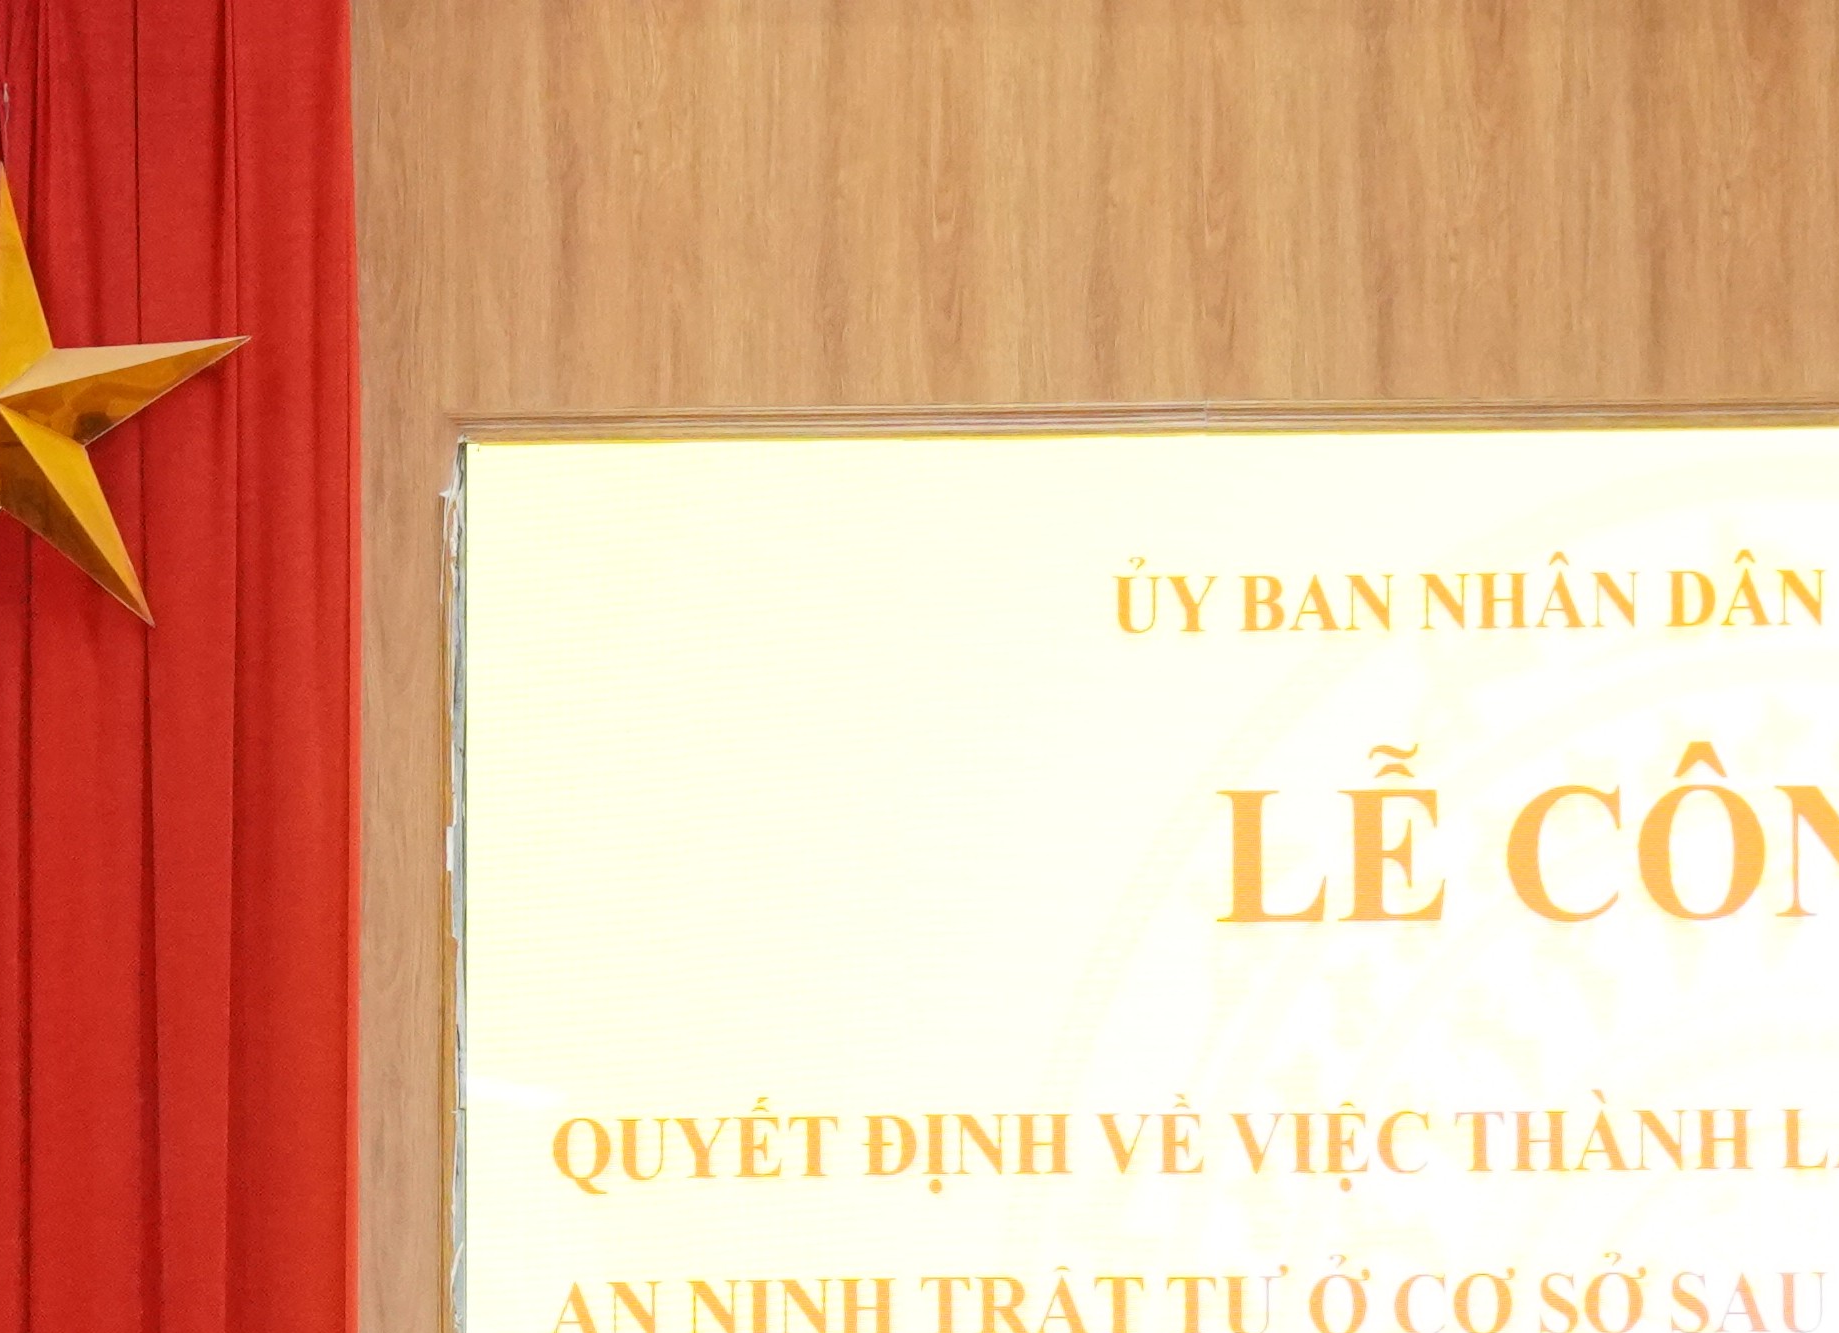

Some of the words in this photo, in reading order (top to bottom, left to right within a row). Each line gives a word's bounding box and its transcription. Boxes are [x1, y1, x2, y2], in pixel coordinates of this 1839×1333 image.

[1114, 556, 1217, 636] ỦY
[1240, 573, 1393, 634] BAN
[1420, 550, 1638, 632] NHÂN
[1667, 547, 1824, 630] DÂN
[1216, 743, 1447, 927] LỄ
[551, 1095, 840, 1197] QUYẾT
[863, 1112, 1072, 1196] ĐỊNH
[1096, 1092, 1205, 1177] VỀ
[1230, 1101, 1431, 1194] VIỆC
[1453, 1087, 1753, 1175] THÀNH
